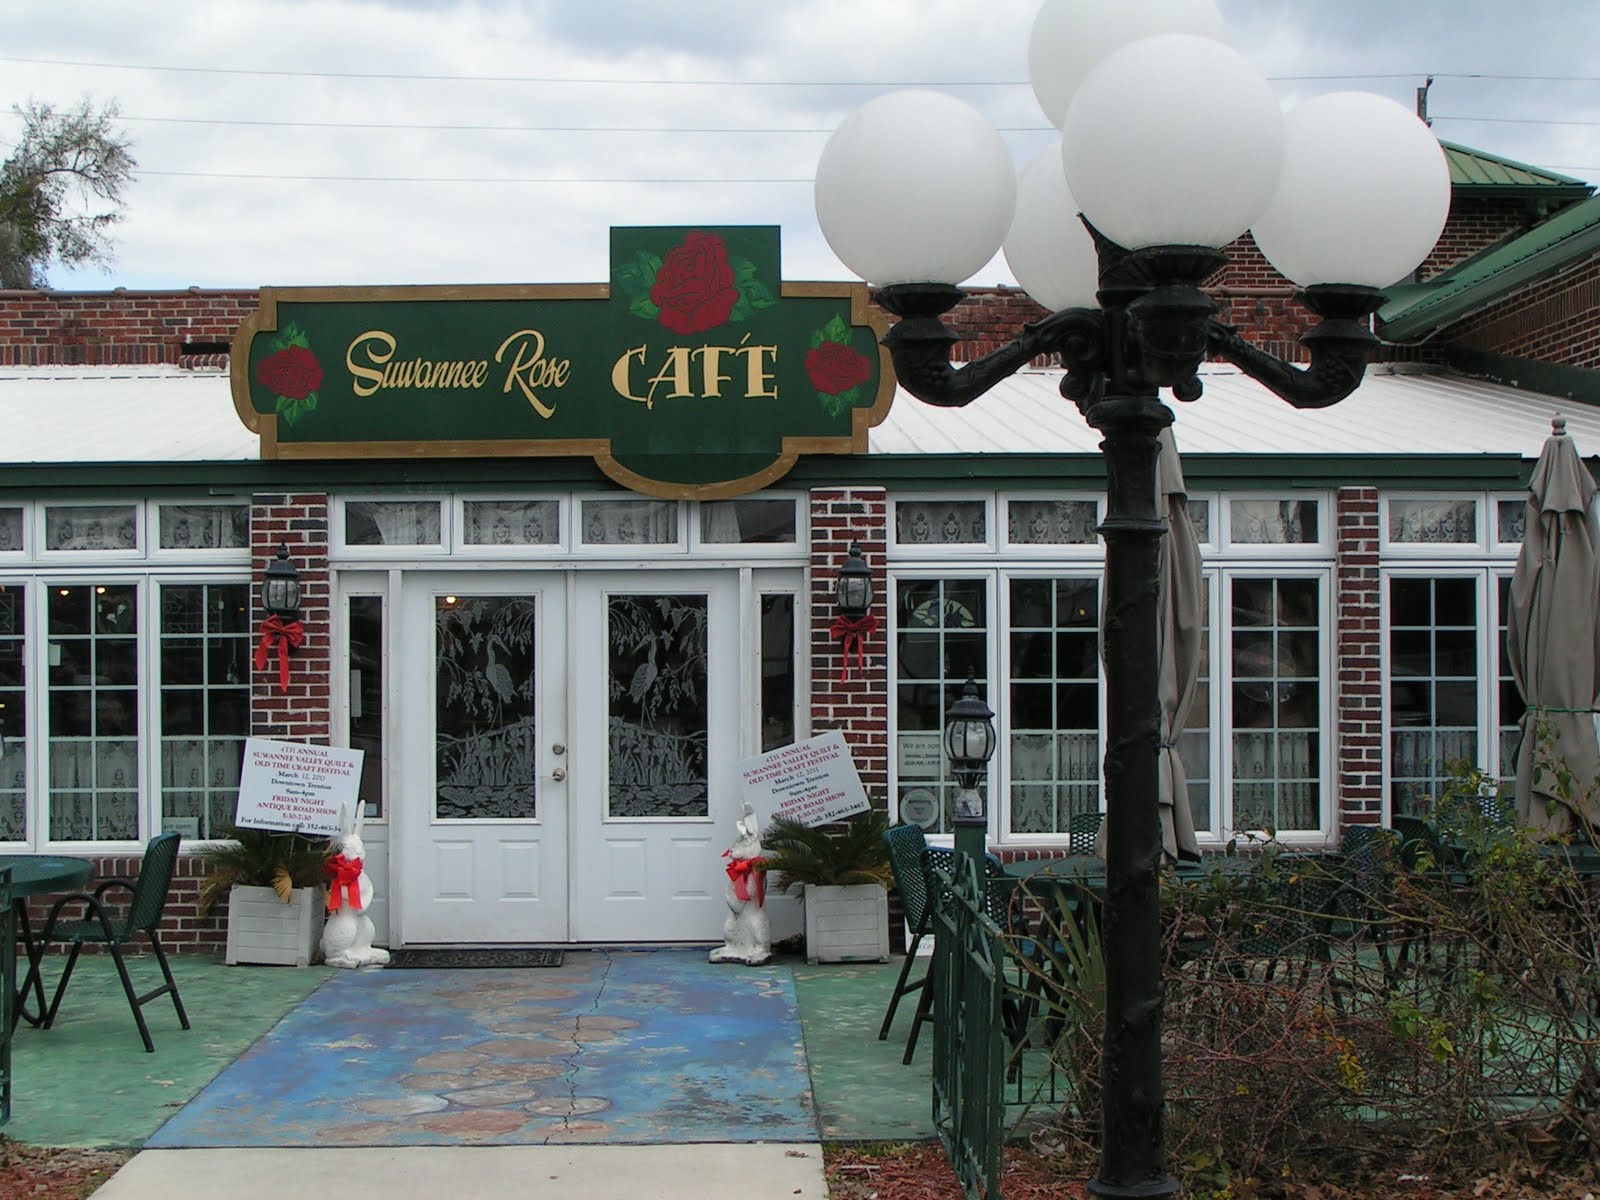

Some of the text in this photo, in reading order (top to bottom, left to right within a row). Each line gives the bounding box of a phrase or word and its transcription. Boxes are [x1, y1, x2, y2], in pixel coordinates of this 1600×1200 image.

[346, 330, 488, 397] Suwannee
[494, 329, 571, 419] Rose
[297, 747, 329, 758] ANNUAL
[780, 744, 812, 758] ANNUAL
[252, 752, 294, 761] SUWANNEE
[296, 756, 324, 764] VALLEY
[324, 759, 347, 768] QUILT
[743, 762, 781, 778] SUWANNEE
[783, 754, 809, 766] VALLEY
[810, 746, 832, 757] QUILT
[278, 770, 299, 778] March
[292, 764, 316, 772] CRAFT
[317, 766, 352, 776] FESTIVAL
[748, 752, 840, 785] OLD TIME CRAFT FESTIVAL
[271, 778, 332, 790] Downtown Trenton
[771, 772, 830, 794] Downtown Trenton
[774, 775, 795, 786] March
[286, 788, 316, 797] 9am-4pm
[780, 788, 830, 808] FRIDAY NIGHT
[272, 795, 325, 806] FRIDAY NIGHT
[804, 798, 824, 810] ROAD
[825, 791, 846, 802] SHOW
[257, 802, 292, 812] ANTIQUE
[293, 806, 314, 814] ROAD
[254, 818, 291, 827] Information
